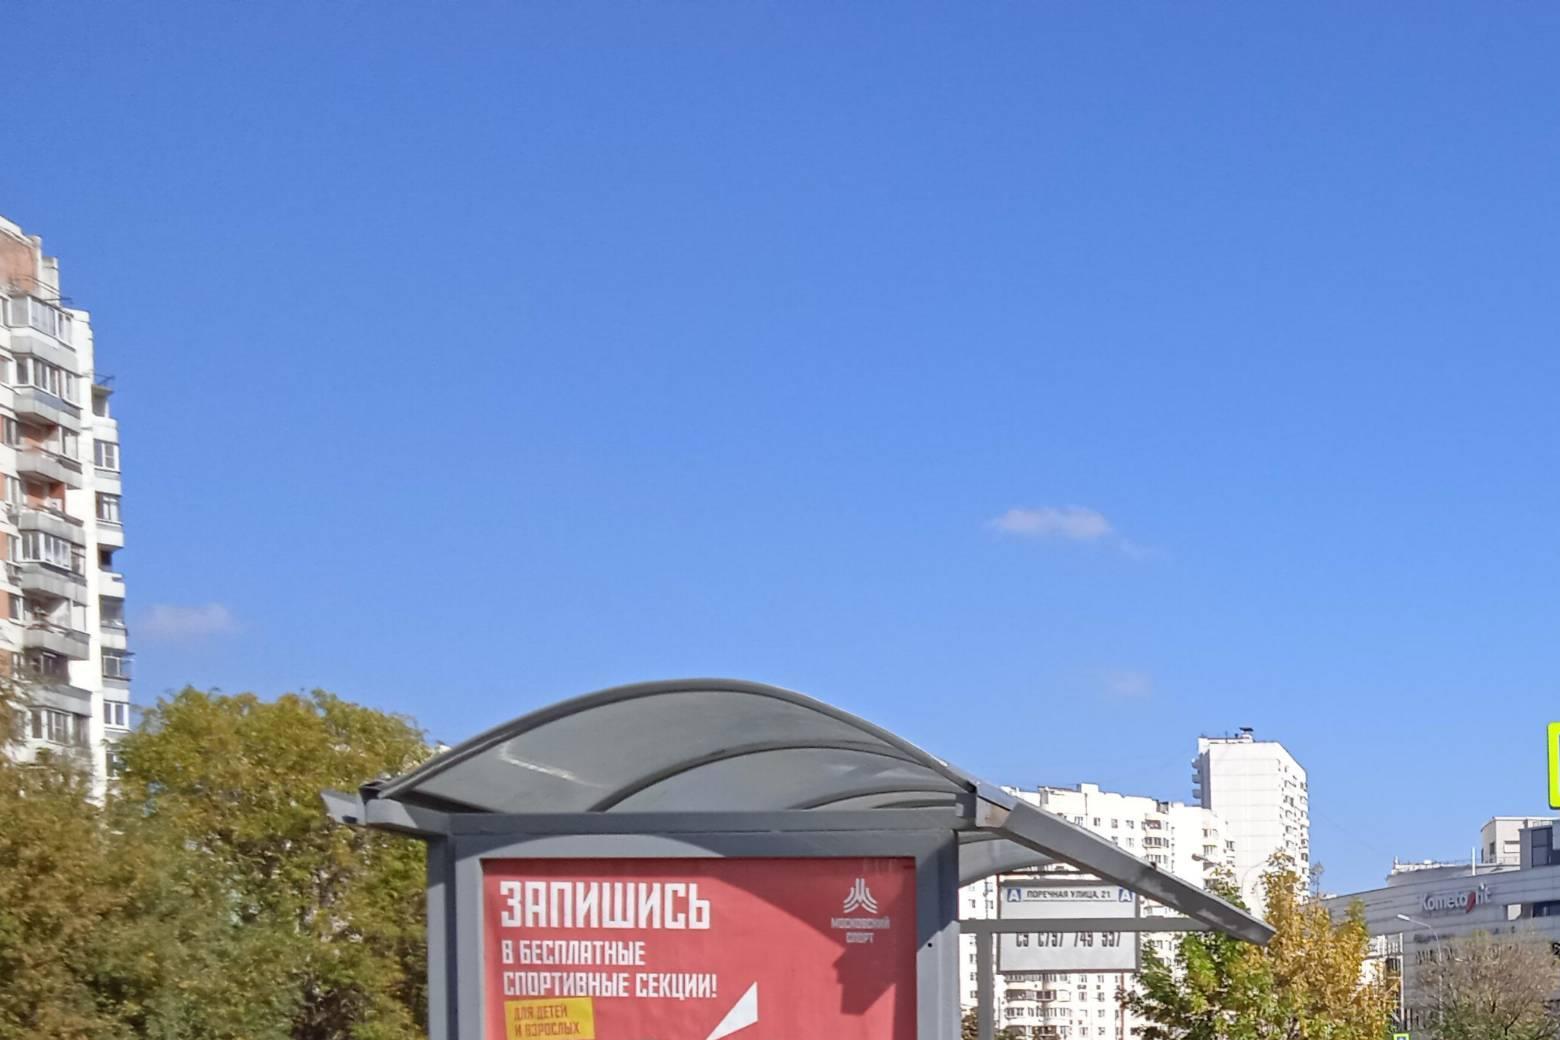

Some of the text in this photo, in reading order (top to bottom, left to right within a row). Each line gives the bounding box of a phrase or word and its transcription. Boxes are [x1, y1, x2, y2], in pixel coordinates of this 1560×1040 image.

[500, 880, 711, 930] ЗАПИШИСЬ
[1026, 889, 1068, 899] ПОРЕЧНАЯ
[1101, 889, 1111, 899] 21
[501, 939, 647, 966] В БЕСПЛАТНЫЕ
[503, 971, 718, 1001] СПОРТИВНЫЕ СЕКЦИИ!
[513, 1003, 568, 1022] ДЛЯ ДЕТЕЙ
[514, 1019, 581, 1037] И ВЗРОСЛЫХ
